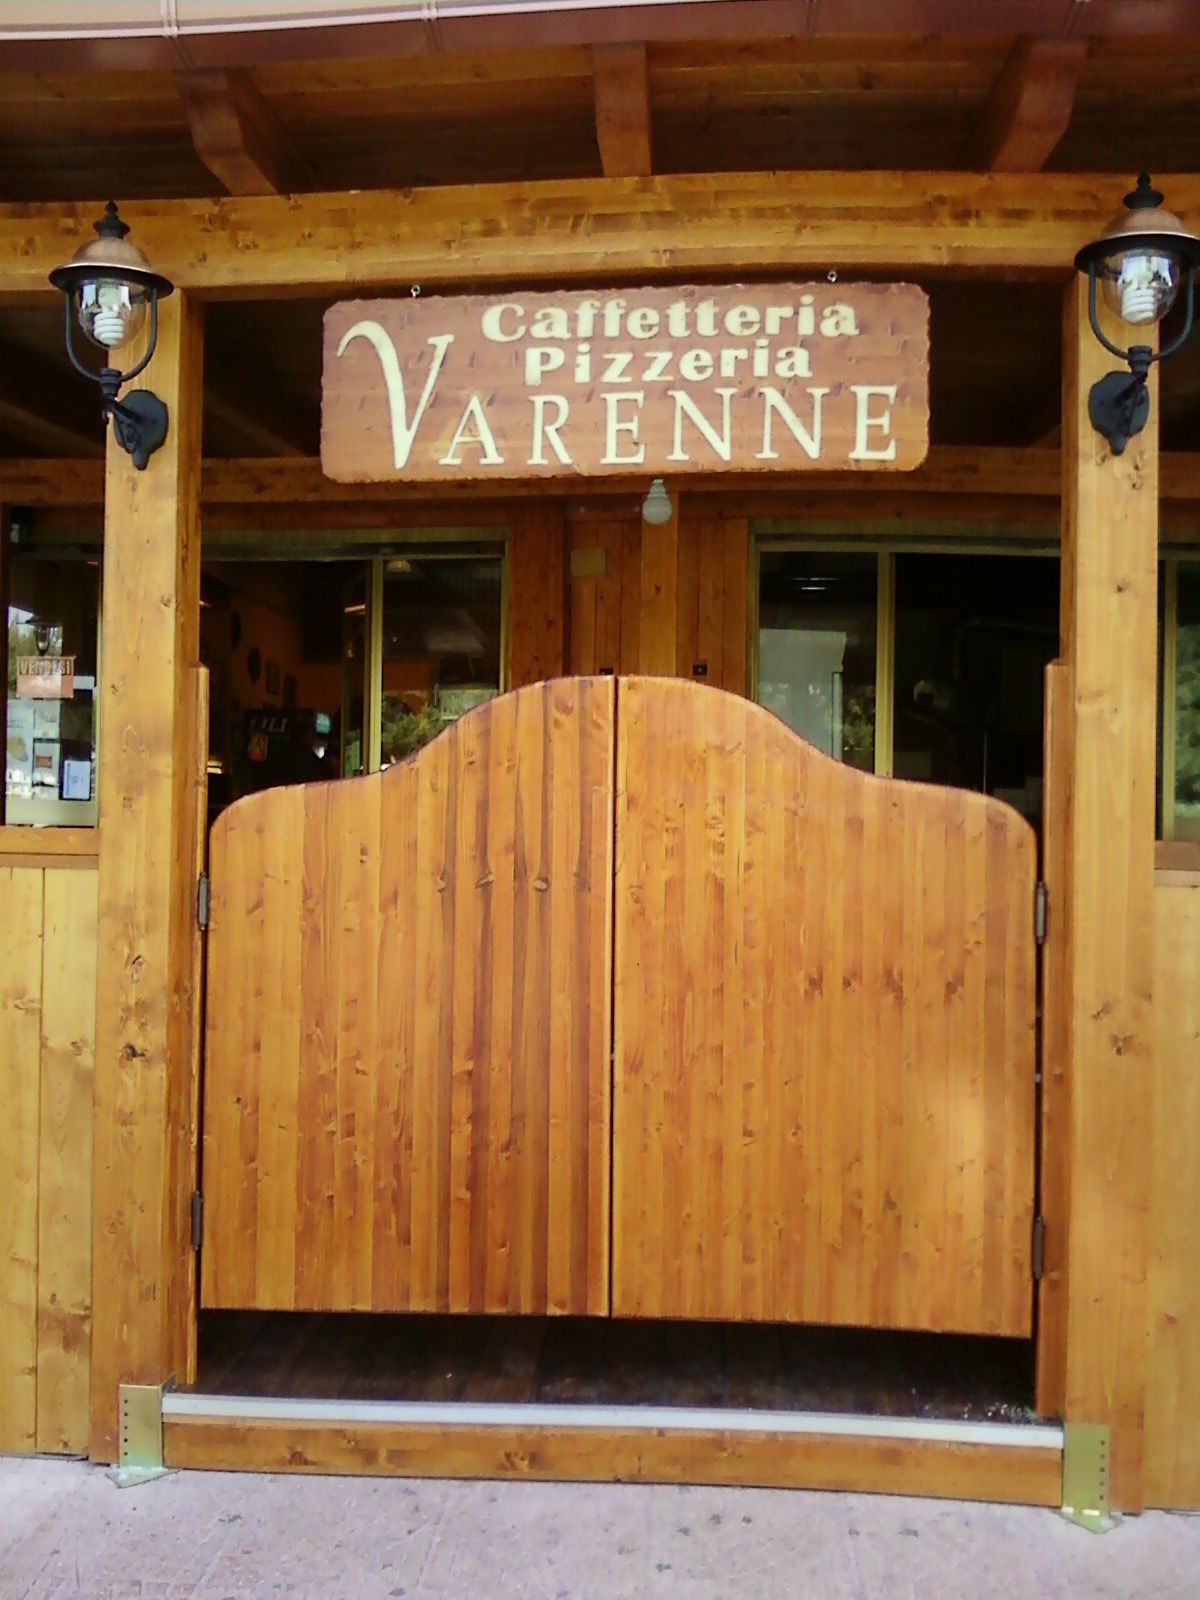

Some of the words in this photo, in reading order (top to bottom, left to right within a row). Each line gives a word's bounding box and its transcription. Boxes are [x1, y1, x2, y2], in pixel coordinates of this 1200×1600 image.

[481, 294, 860, 342] Caffetteria
[524, 339, 812, 387] Pizzeria
[337, 320, 898, 470] VARENNE
